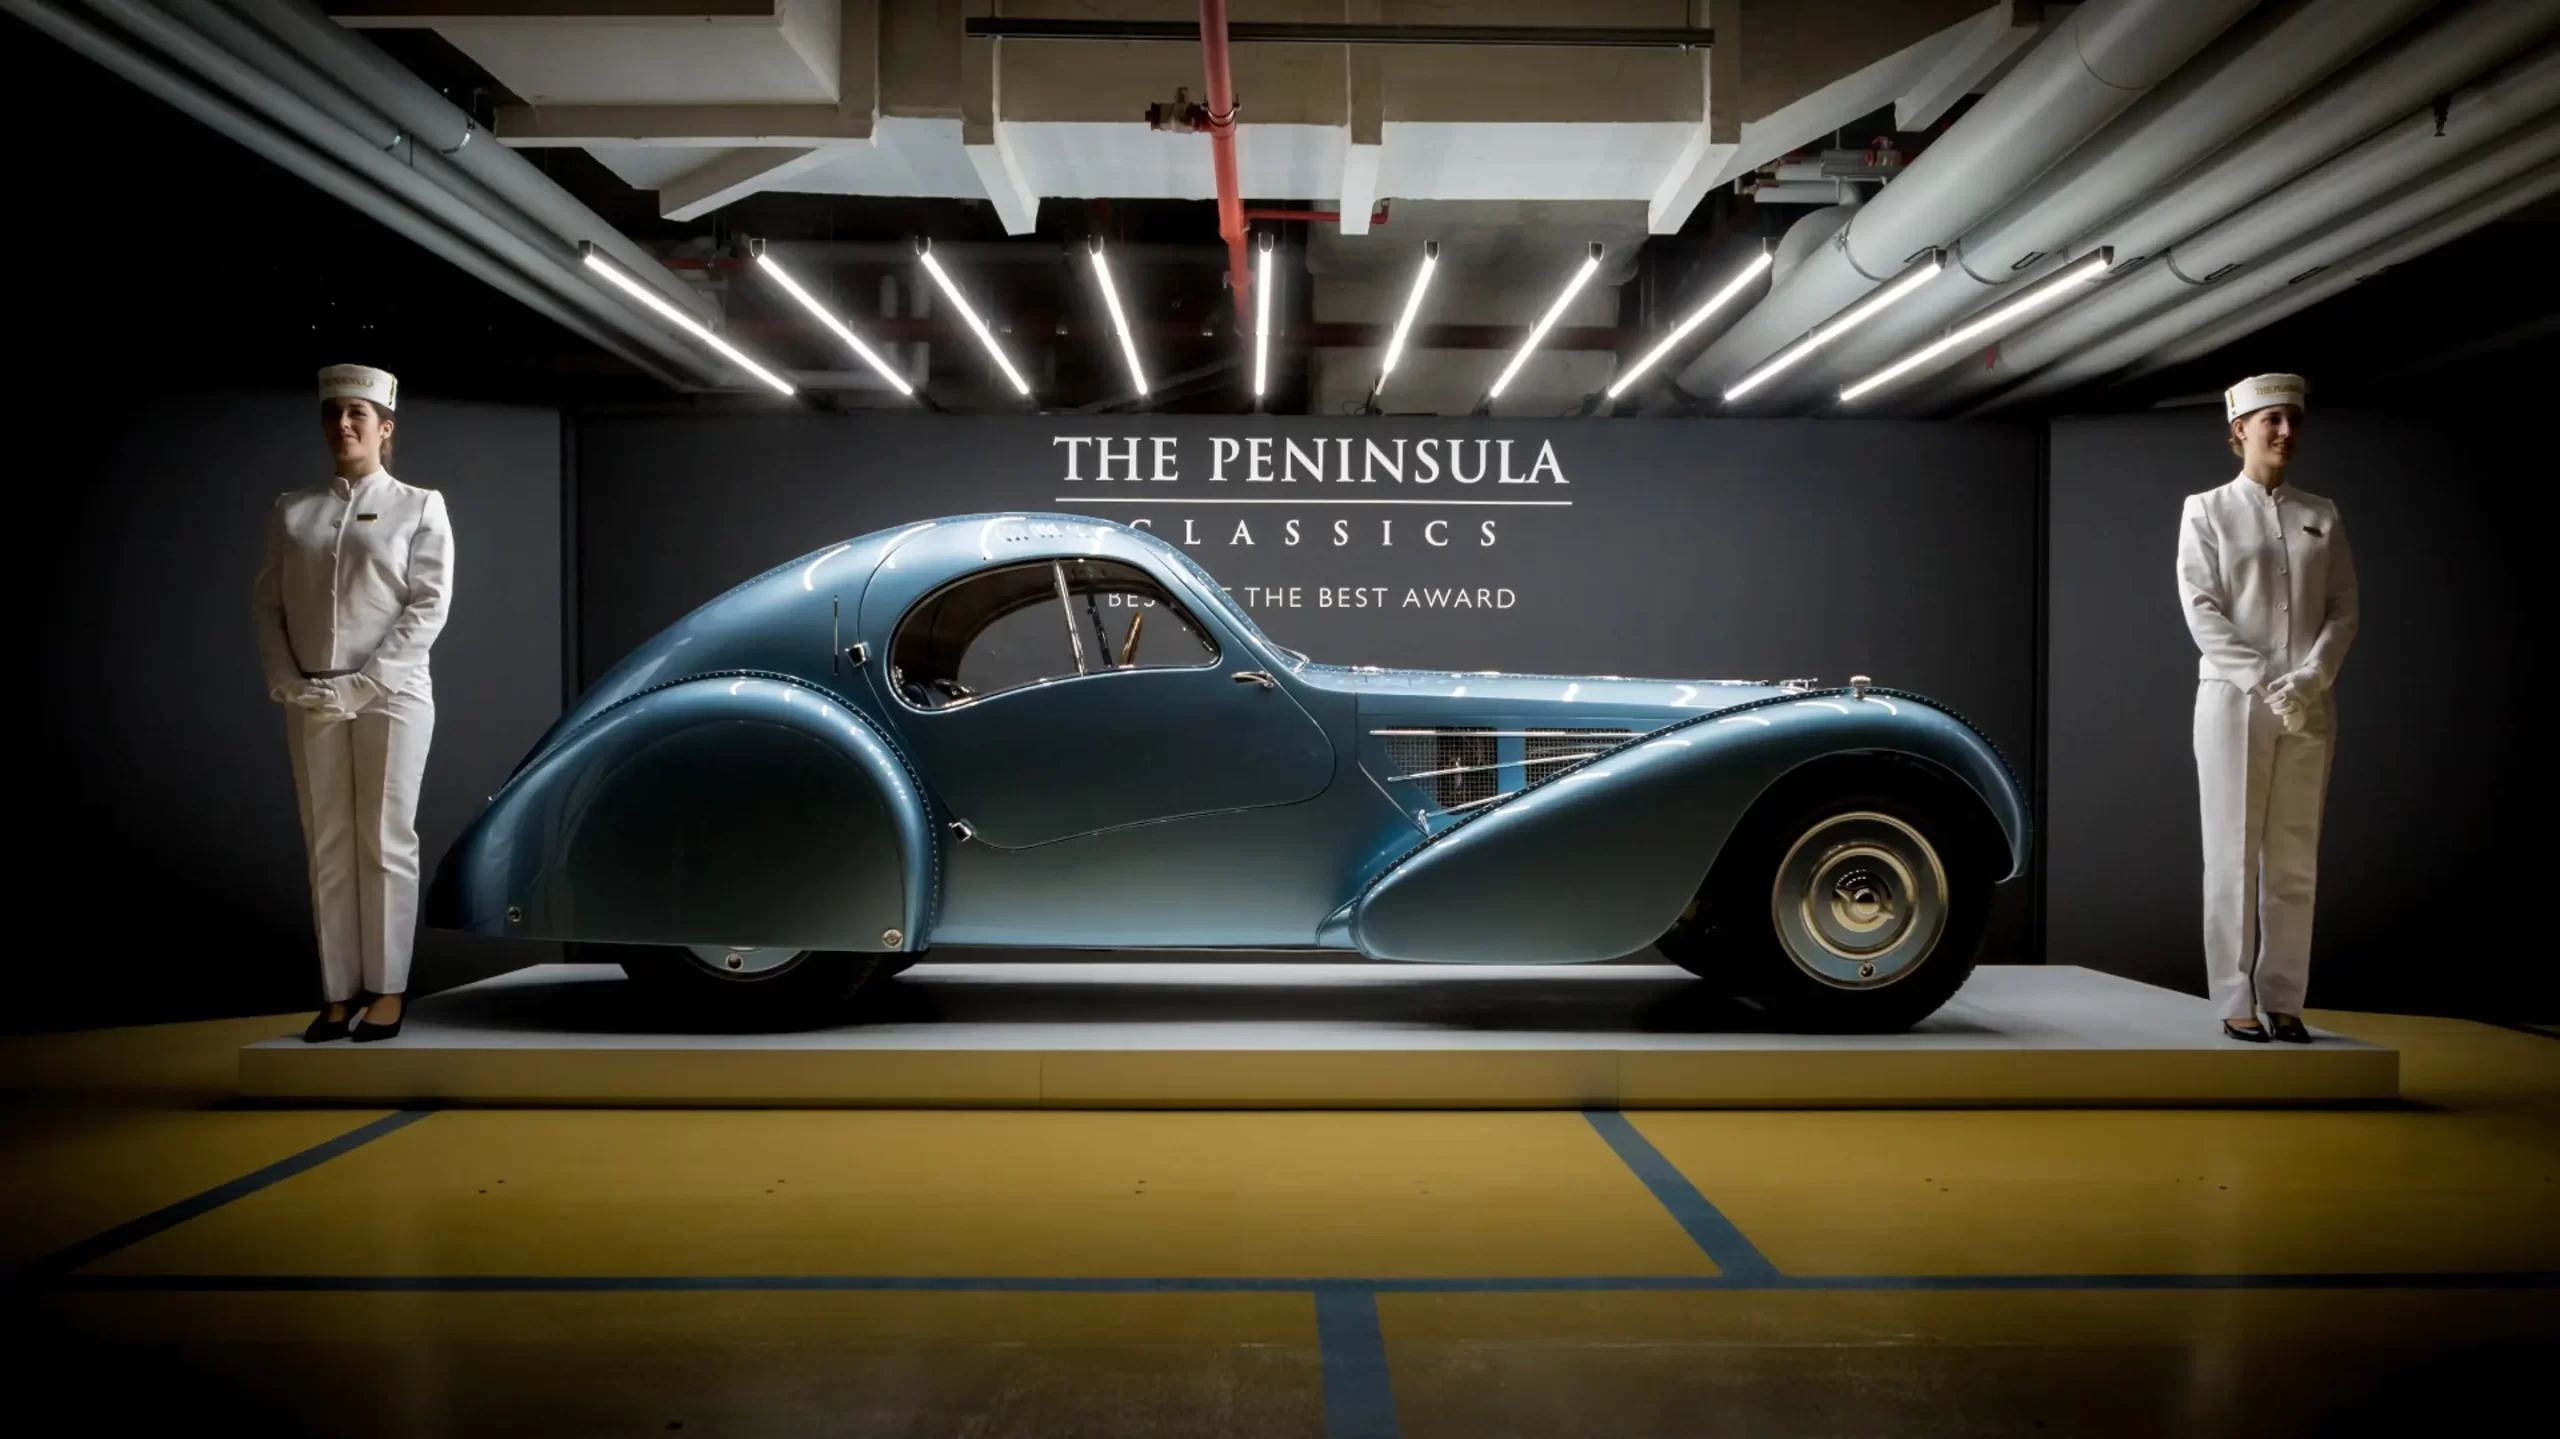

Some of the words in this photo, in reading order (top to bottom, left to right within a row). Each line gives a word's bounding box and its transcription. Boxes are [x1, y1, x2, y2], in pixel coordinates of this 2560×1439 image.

[1052, 435, 1179, 482] THE
[1208, 436, 1570, 484] PENINSULA
[1243, 586, 1303, 608] THE
[1319, 586, 1389, 609] BEST
[1401, 587, 1516, 610] AWARD
